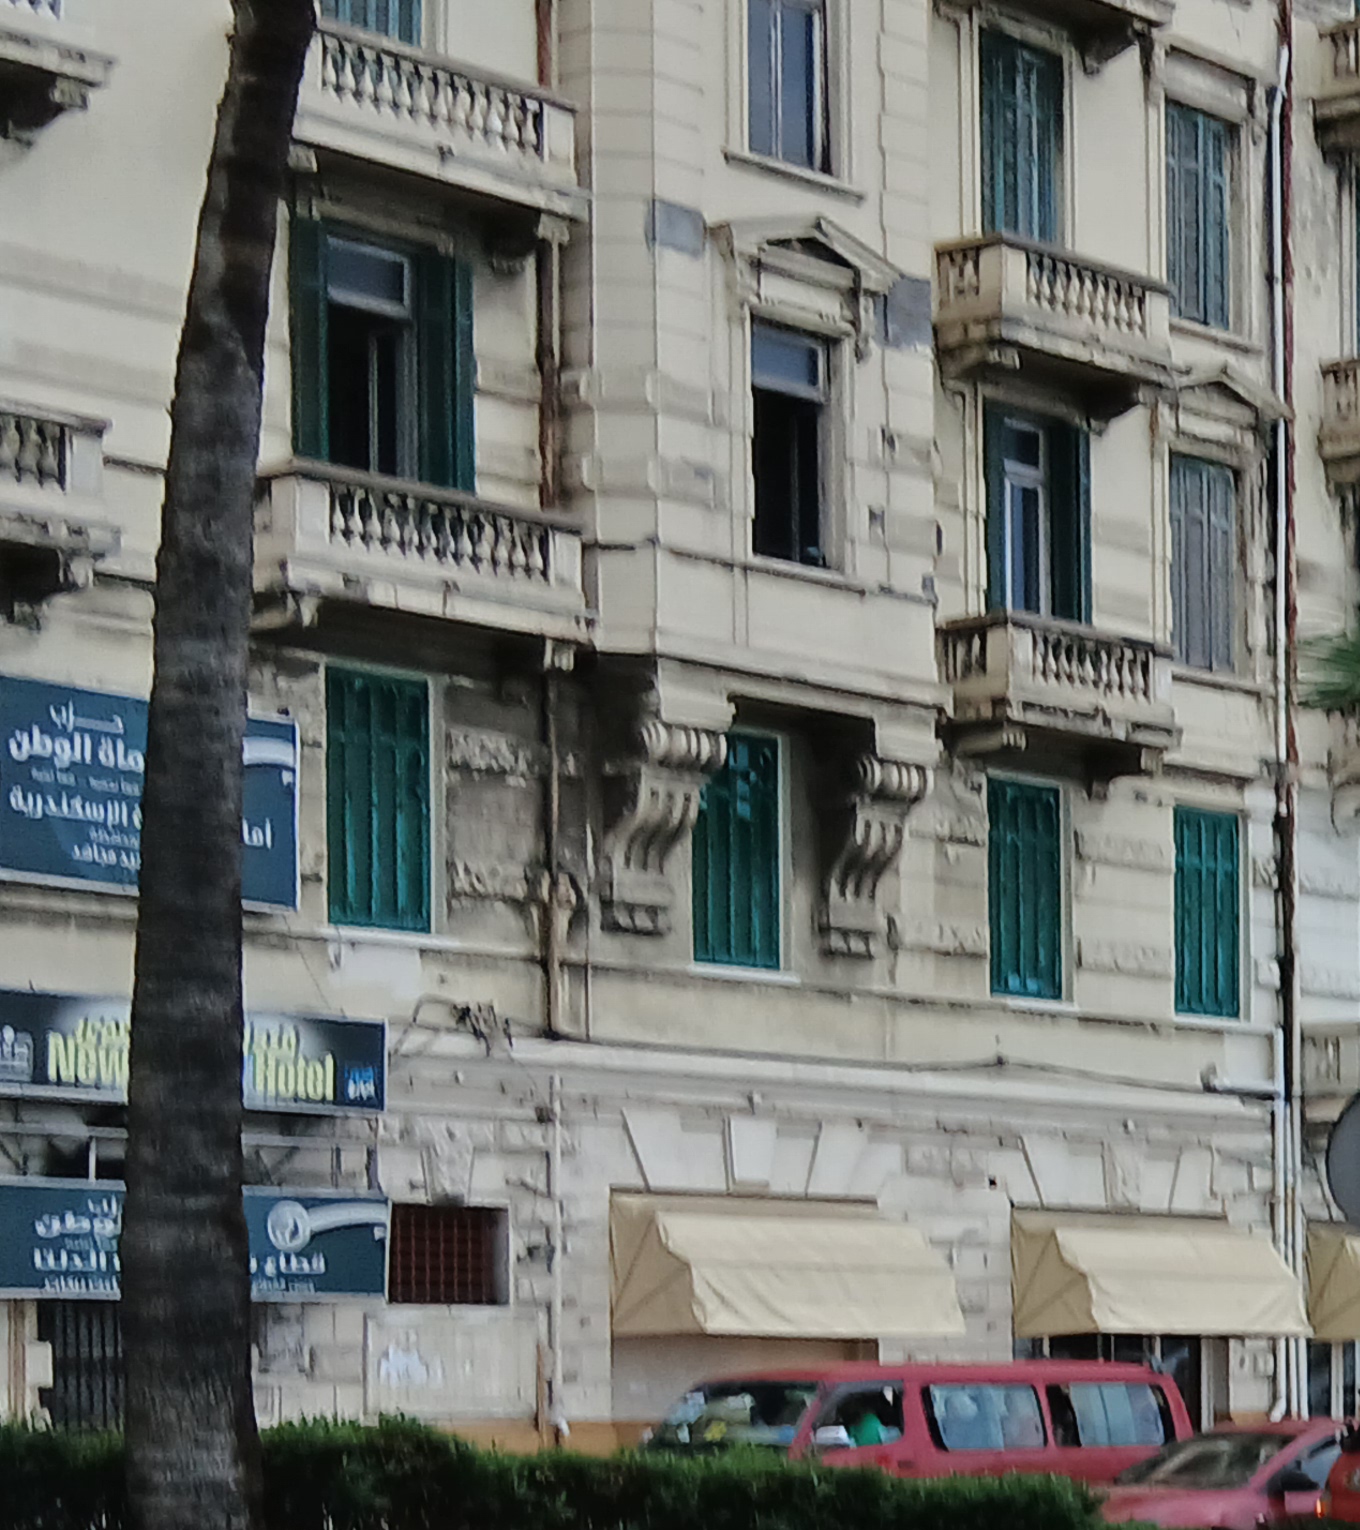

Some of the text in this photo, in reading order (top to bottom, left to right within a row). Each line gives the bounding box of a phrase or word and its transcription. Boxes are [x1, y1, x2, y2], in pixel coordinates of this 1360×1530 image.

[8, 722, 145, 773] ماة الوطن
[47, 1031, 129, 1086] New
[254, 1048, 334, 1101] Hotel
